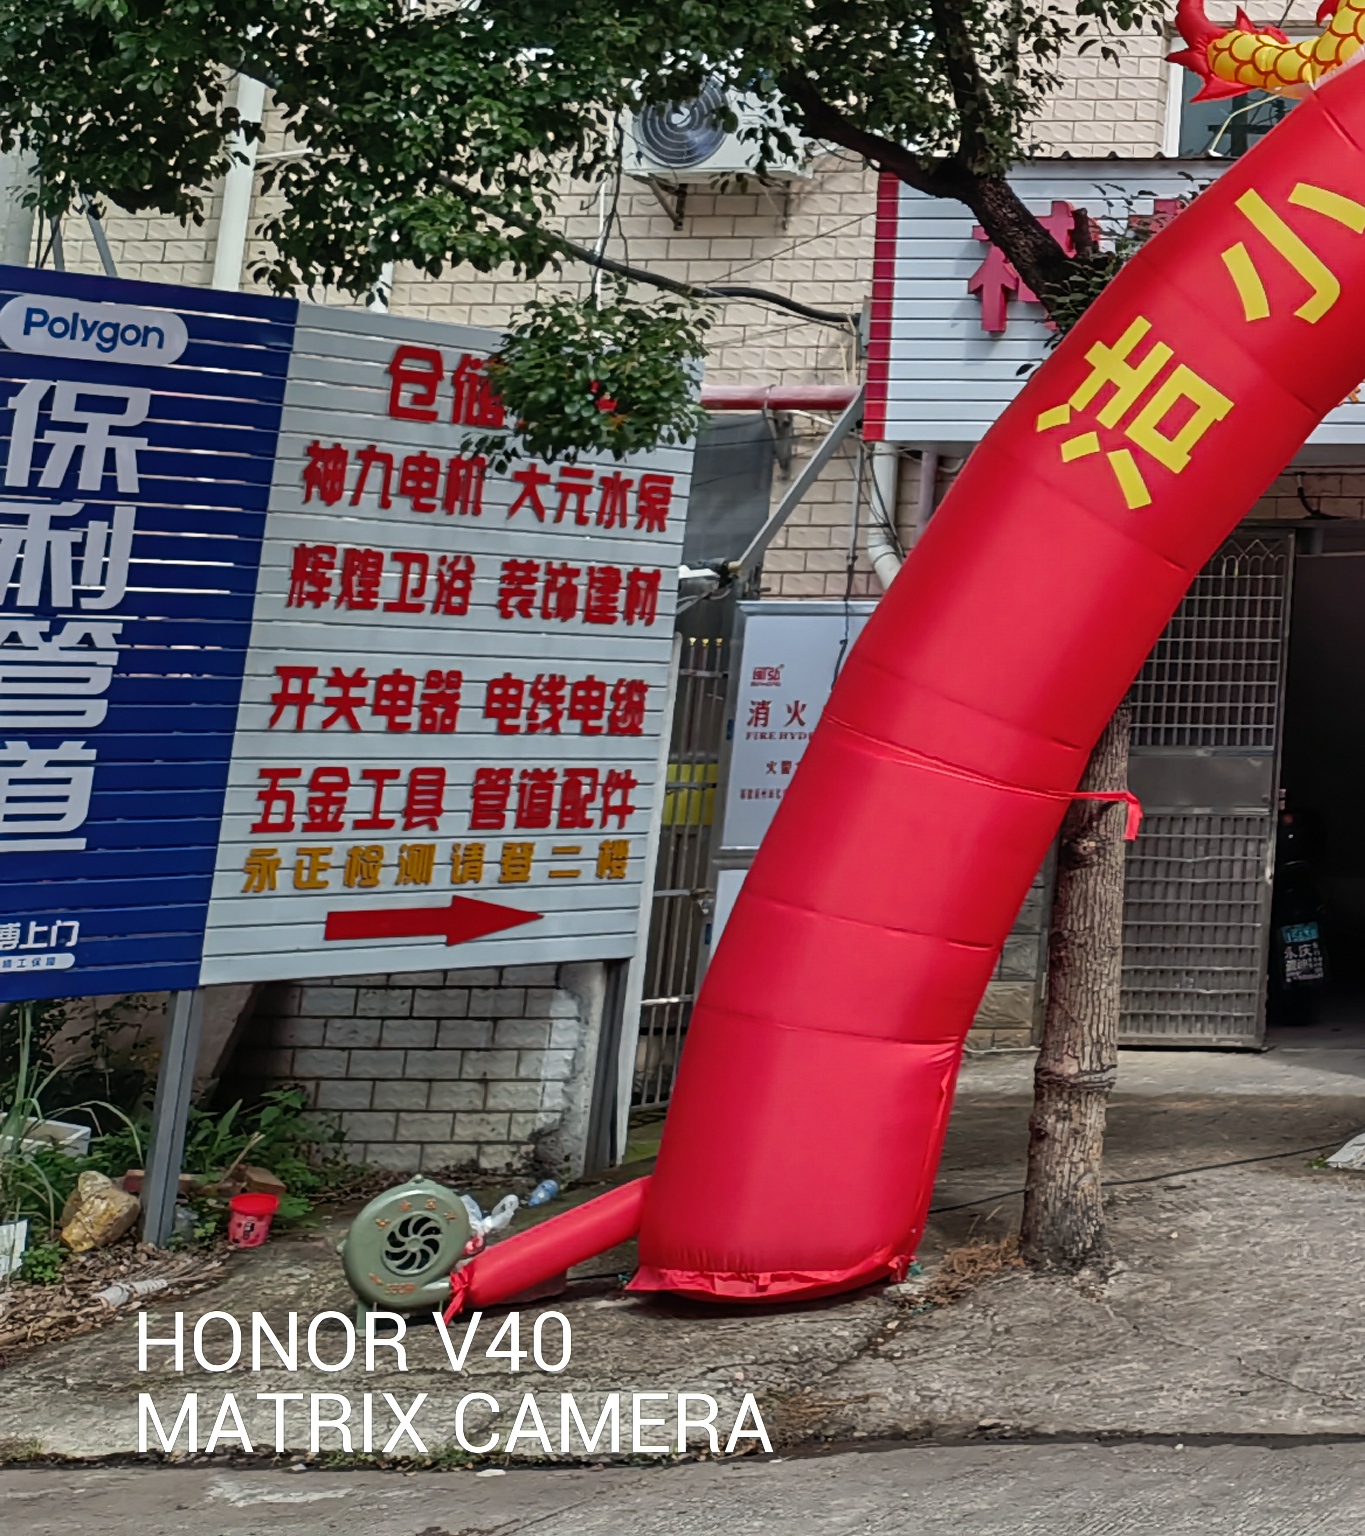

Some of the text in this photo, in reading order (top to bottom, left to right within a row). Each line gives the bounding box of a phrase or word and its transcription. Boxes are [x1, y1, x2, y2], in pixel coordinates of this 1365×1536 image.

[23, 307, 165, 353] Polygon
[303, 439, 675, 534] 神九电机 大元水泵
[287, 543, 663, 627] 辉煌卫浴 装饰建材
[268, 666, 649, 736] 开关电器 电线电缆
[745, 731, 777, 741] FIRE
[251, 766, 640, 834] 五金工具 管道配件
